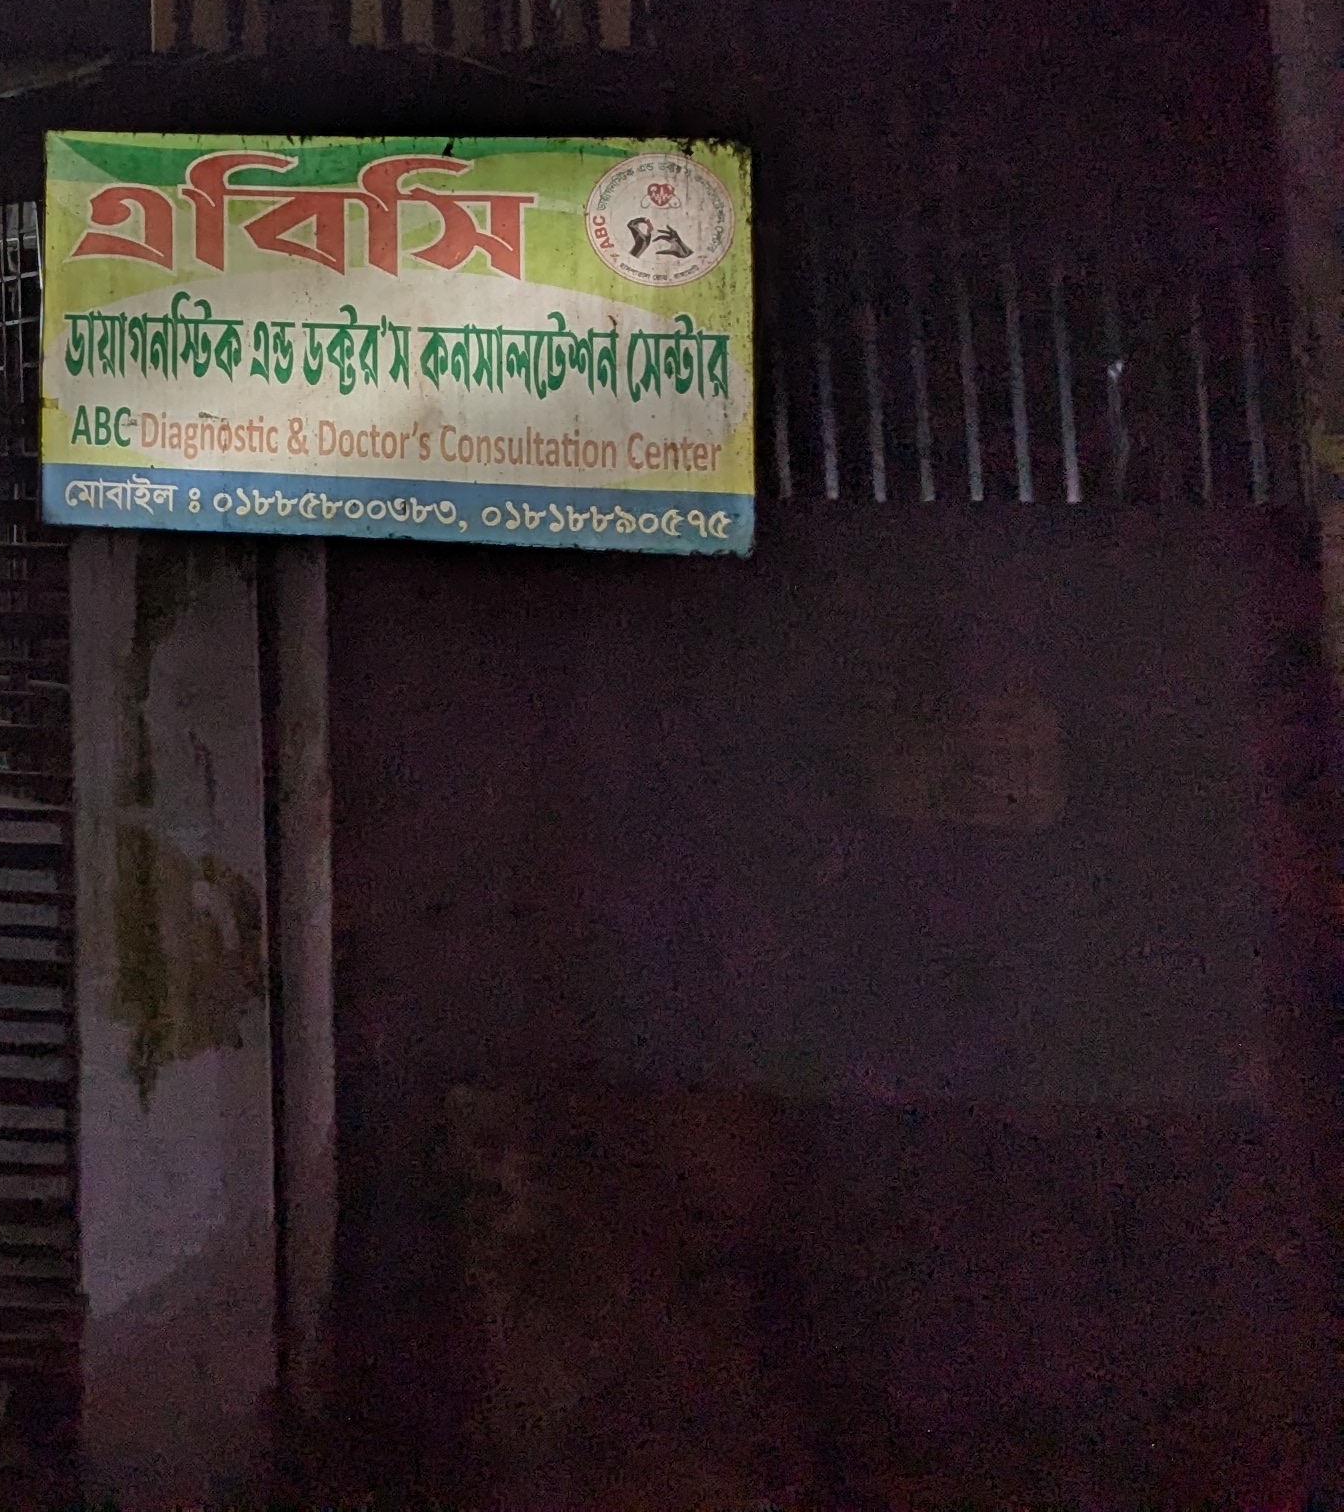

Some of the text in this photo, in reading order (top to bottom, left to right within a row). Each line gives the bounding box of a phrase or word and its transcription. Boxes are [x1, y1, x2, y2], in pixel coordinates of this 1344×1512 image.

[64, 150, 538, 281] এবিসি
[592, 215, 614, 250] ABC
[64, 291, 243, 383] ডায়াগনস্টিক
[250, 320, 295, 384] এন্ড
[418, 312, 619, 400] কনসালটেশন
[628, 314, 730, 403] সেন্টার
[70, 404, 722, 472] ABC Diagnostic & Doctor's Consultation Center
[64, 473, 179, 514] মোবাইল
[481, 500, 732, 540] ০১৮১৮৮৯০৫৭৫
